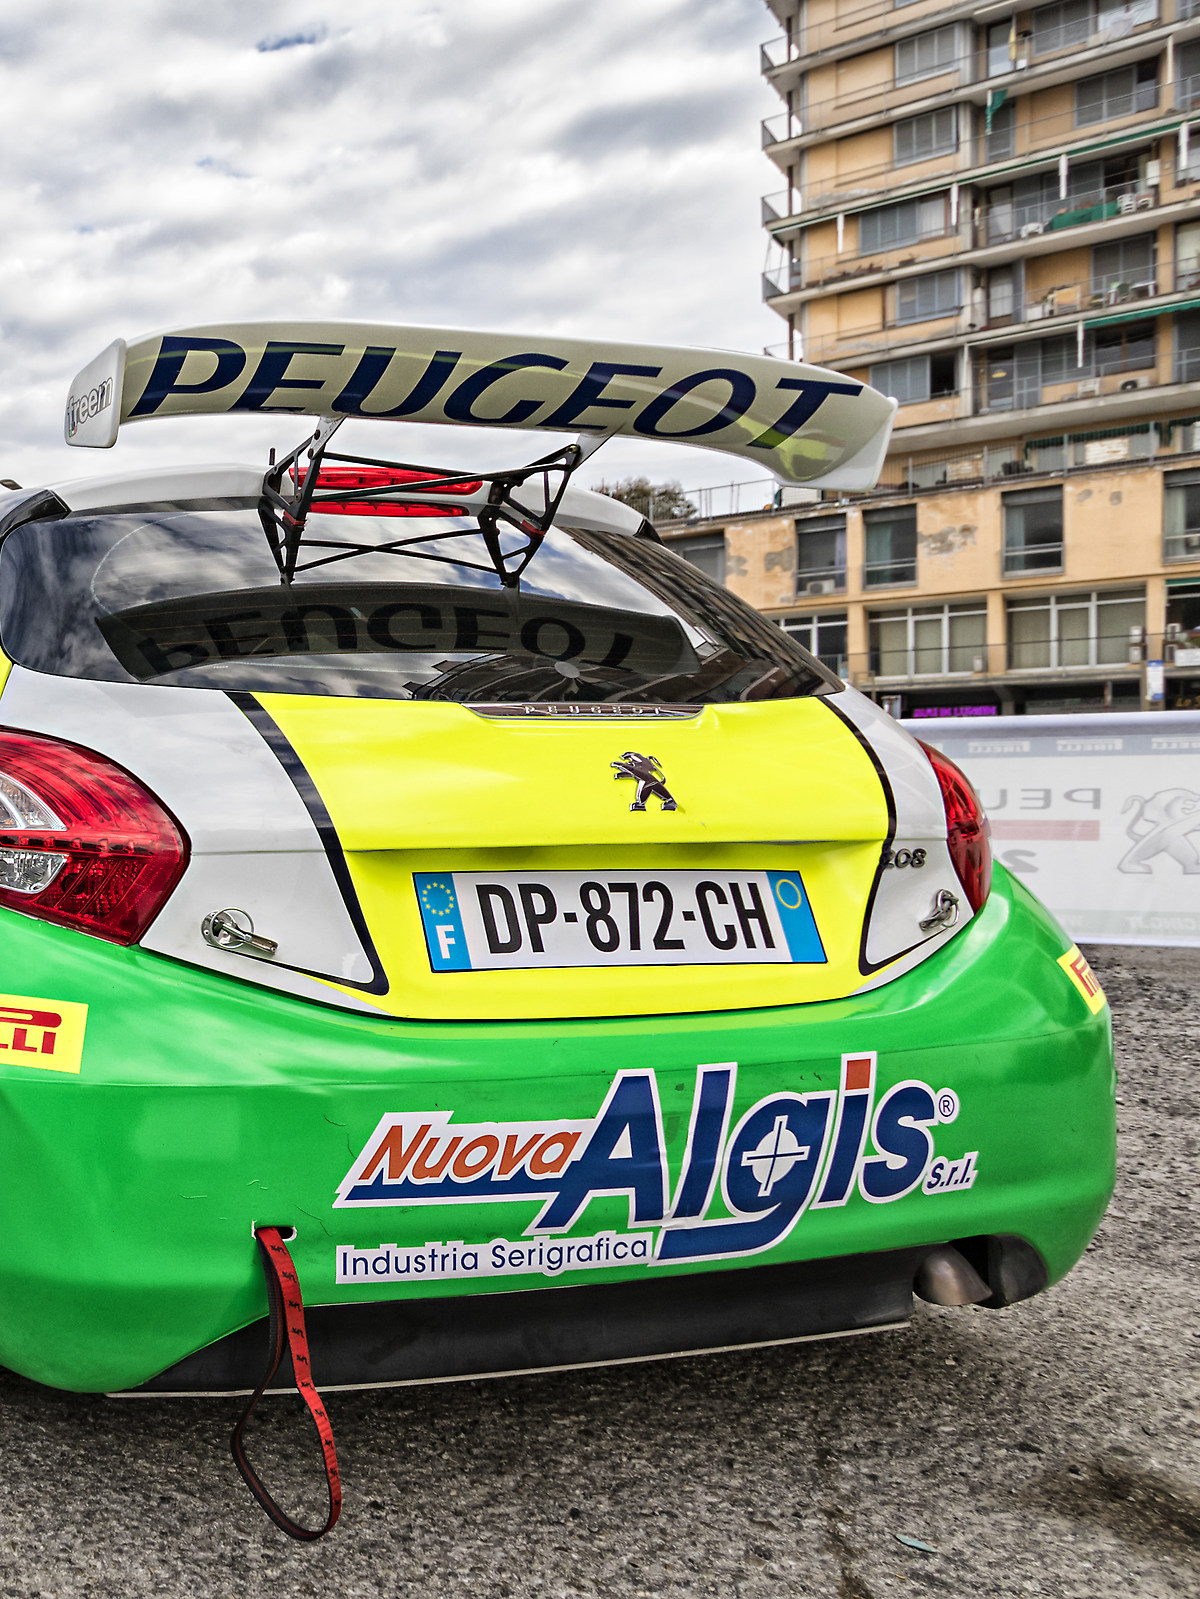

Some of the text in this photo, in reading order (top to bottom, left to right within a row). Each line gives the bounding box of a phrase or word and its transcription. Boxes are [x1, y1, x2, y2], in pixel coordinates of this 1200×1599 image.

[66, 377, 114, 437] freem
[128, 336, 863, 450] PEUGEOT
[524, 705, 663, 716] PEUGEOT
[884, 848, 927, 869] 208
[435, 924, 456, 959] F
[475, 881, 776, 954] DP-872-CH
[358, 1058, 976, 1260] Nuova Algis S.r.l.
[341, 1236, 648, 1277] Industria Serigrafica
